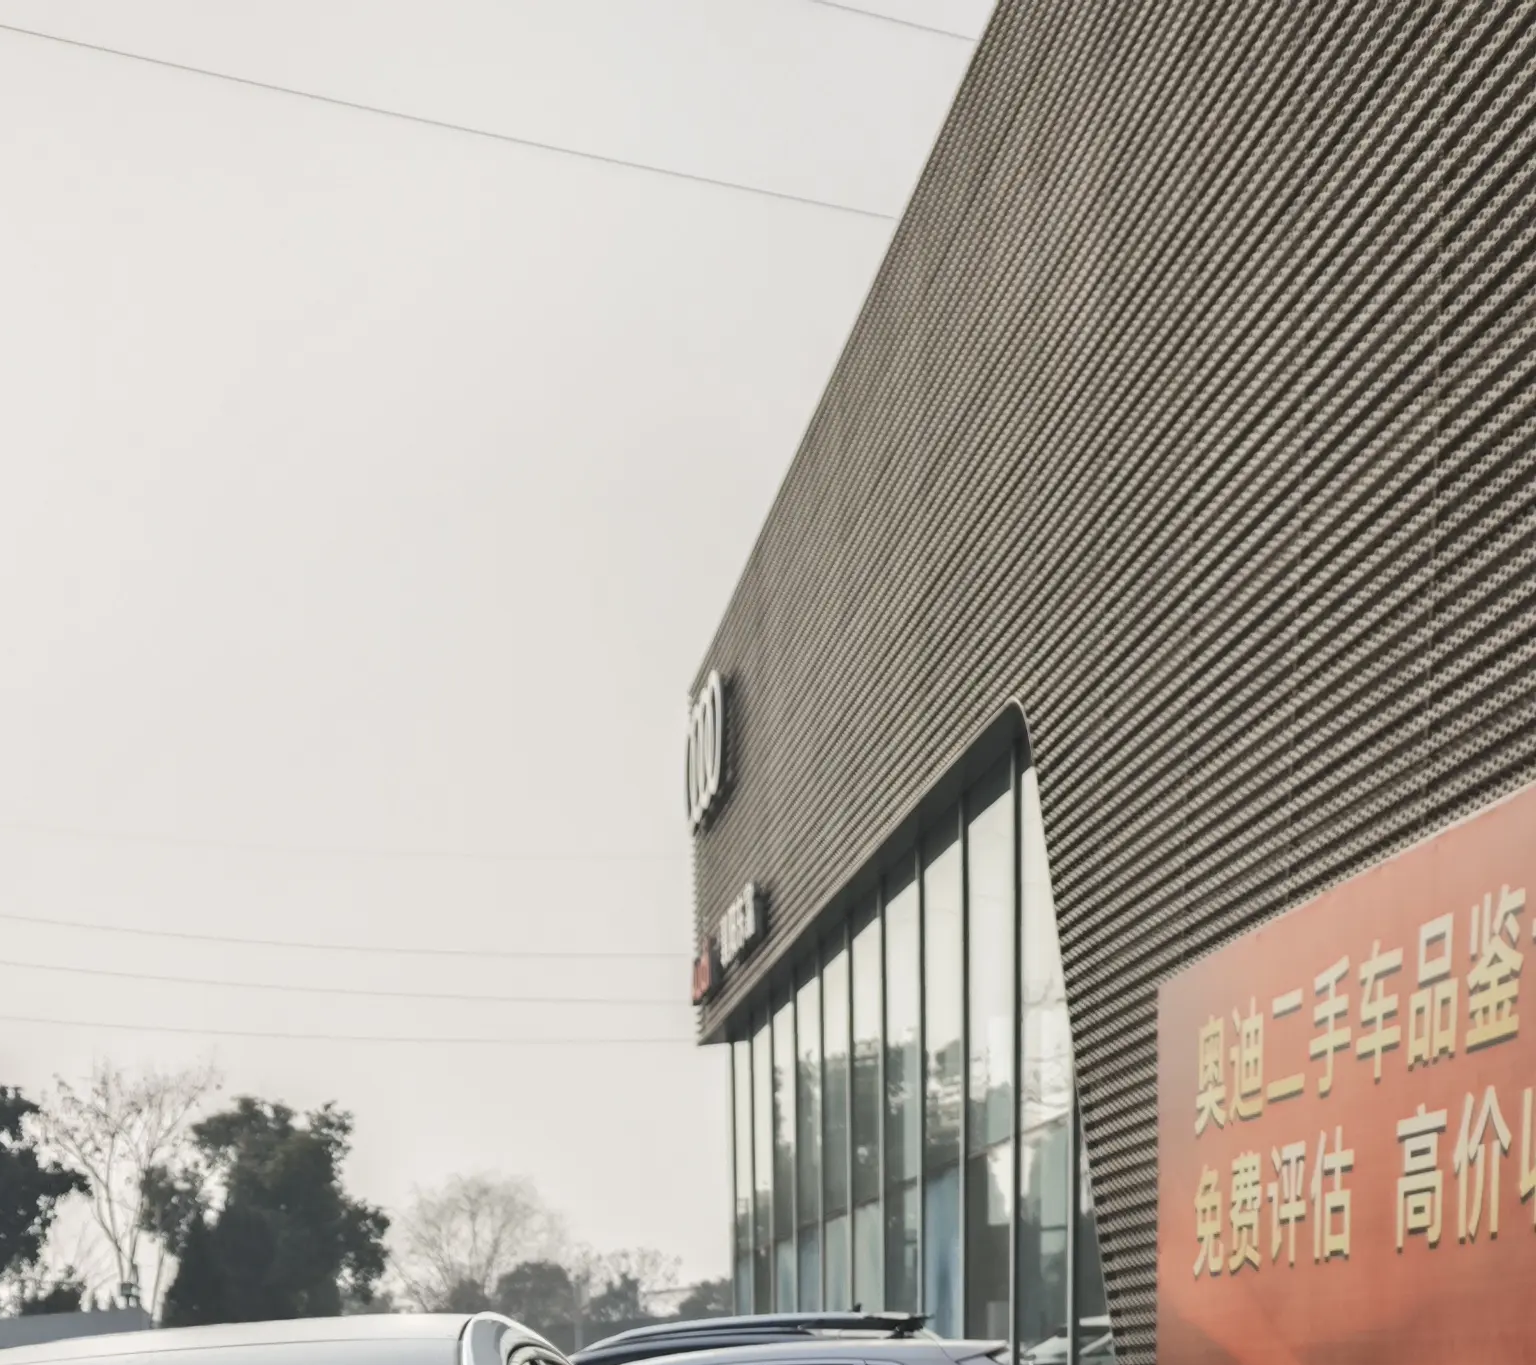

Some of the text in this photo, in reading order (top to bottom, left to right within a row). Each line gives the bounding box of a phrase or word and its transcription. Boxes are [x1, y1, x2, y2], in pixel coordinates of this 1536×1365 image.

[1194, 883, 1536, 1139] 奥迪二手车品鉴
[1193, 1124, 1355, 1279] 免费评估
